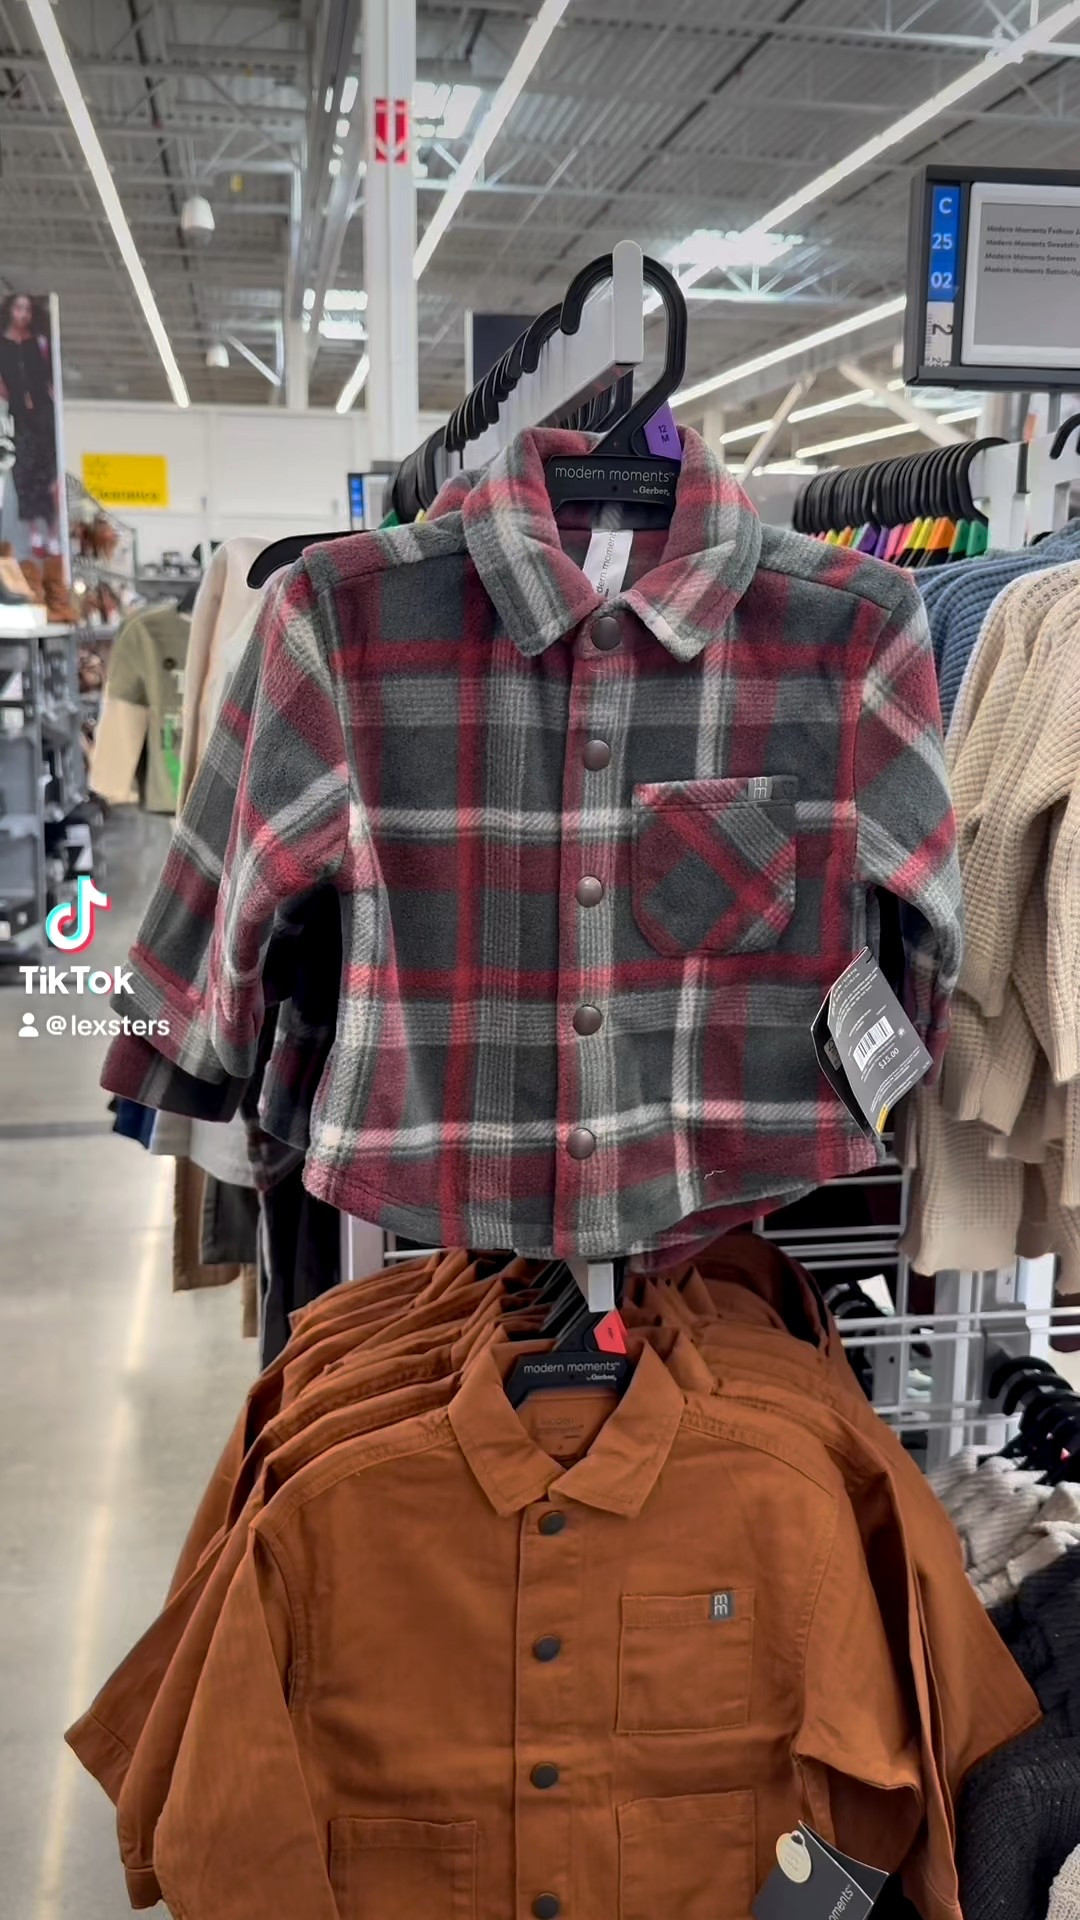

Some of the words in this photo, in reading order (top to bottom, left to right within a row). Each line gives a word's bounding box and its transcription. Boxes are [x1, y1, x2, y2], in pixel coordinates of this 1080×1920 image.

[938, 197, 952, 214] C
[932, 232, 953, 251] 25
[931, 271, 953, 289] 02
[658, 424, 668, 433] 12
[661, 434, 670, 443] M
[555, 466, 605, 480] modern
[878, 1047, 900, 1069] $15.00
[523, 1363, 564, 1374] modern
